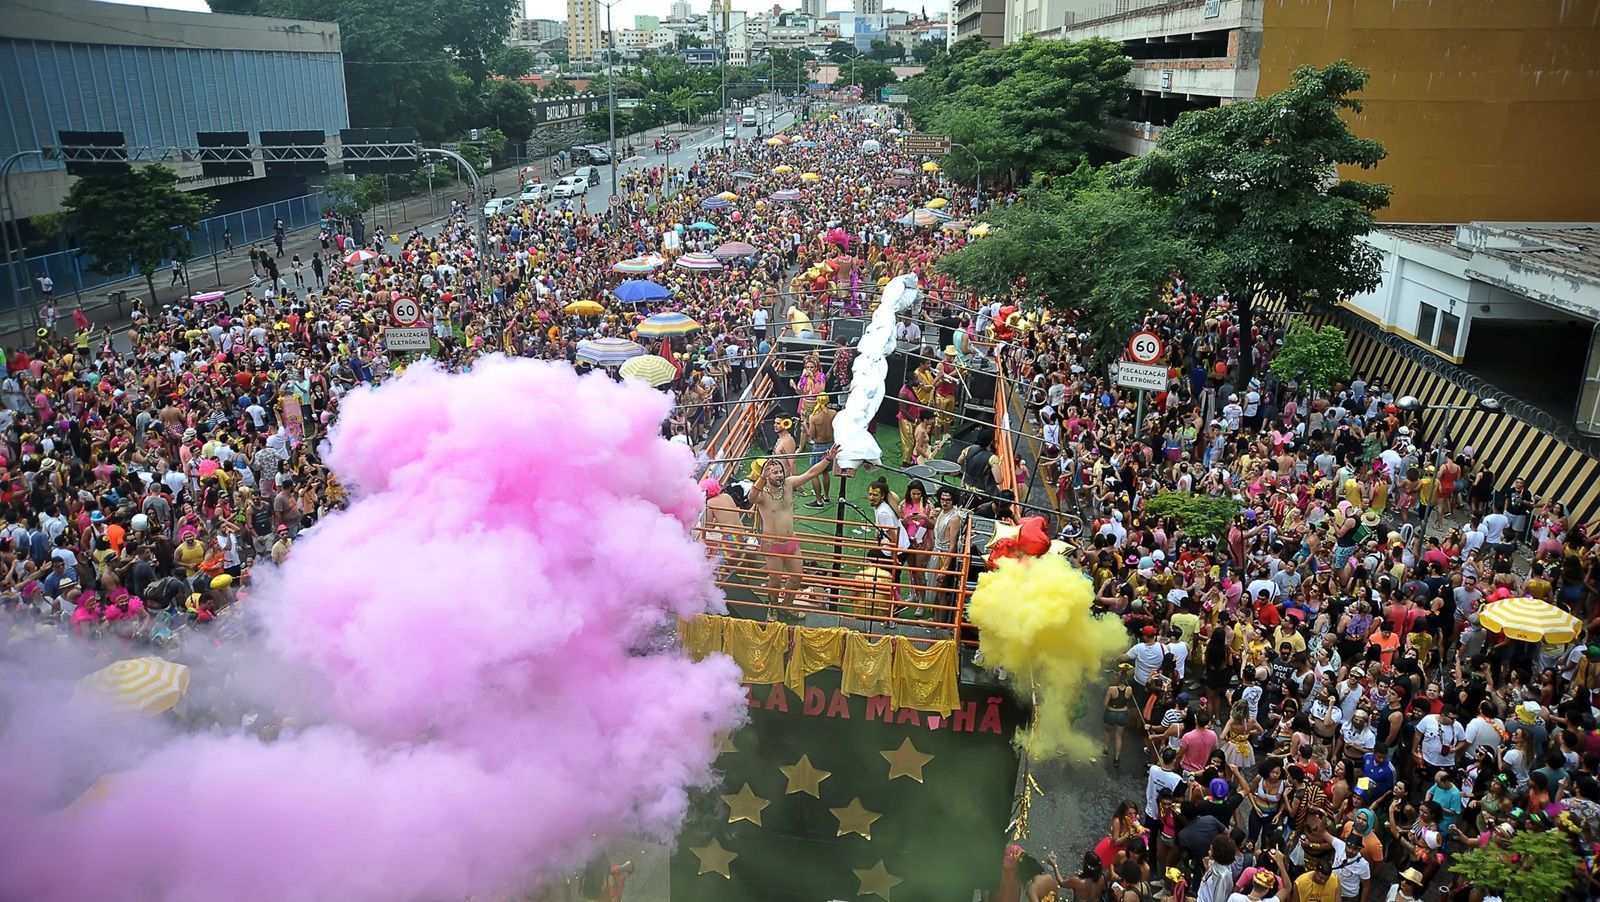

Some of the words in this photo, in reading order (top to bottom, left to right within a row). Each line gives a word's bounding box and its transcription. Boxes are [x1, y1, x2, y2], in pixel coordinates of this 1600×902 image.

[396, 305, 415, 316] 60
[1136, 340, 1156, 353] 60
[1120, 366, 1166, 378] FISCALIZAÇÃO
[1122, 375, 1162, 386] ELETRÔNICA
[803, 686, 850, 719] DA
[865, 696, 1002, 734] MAHÃ
